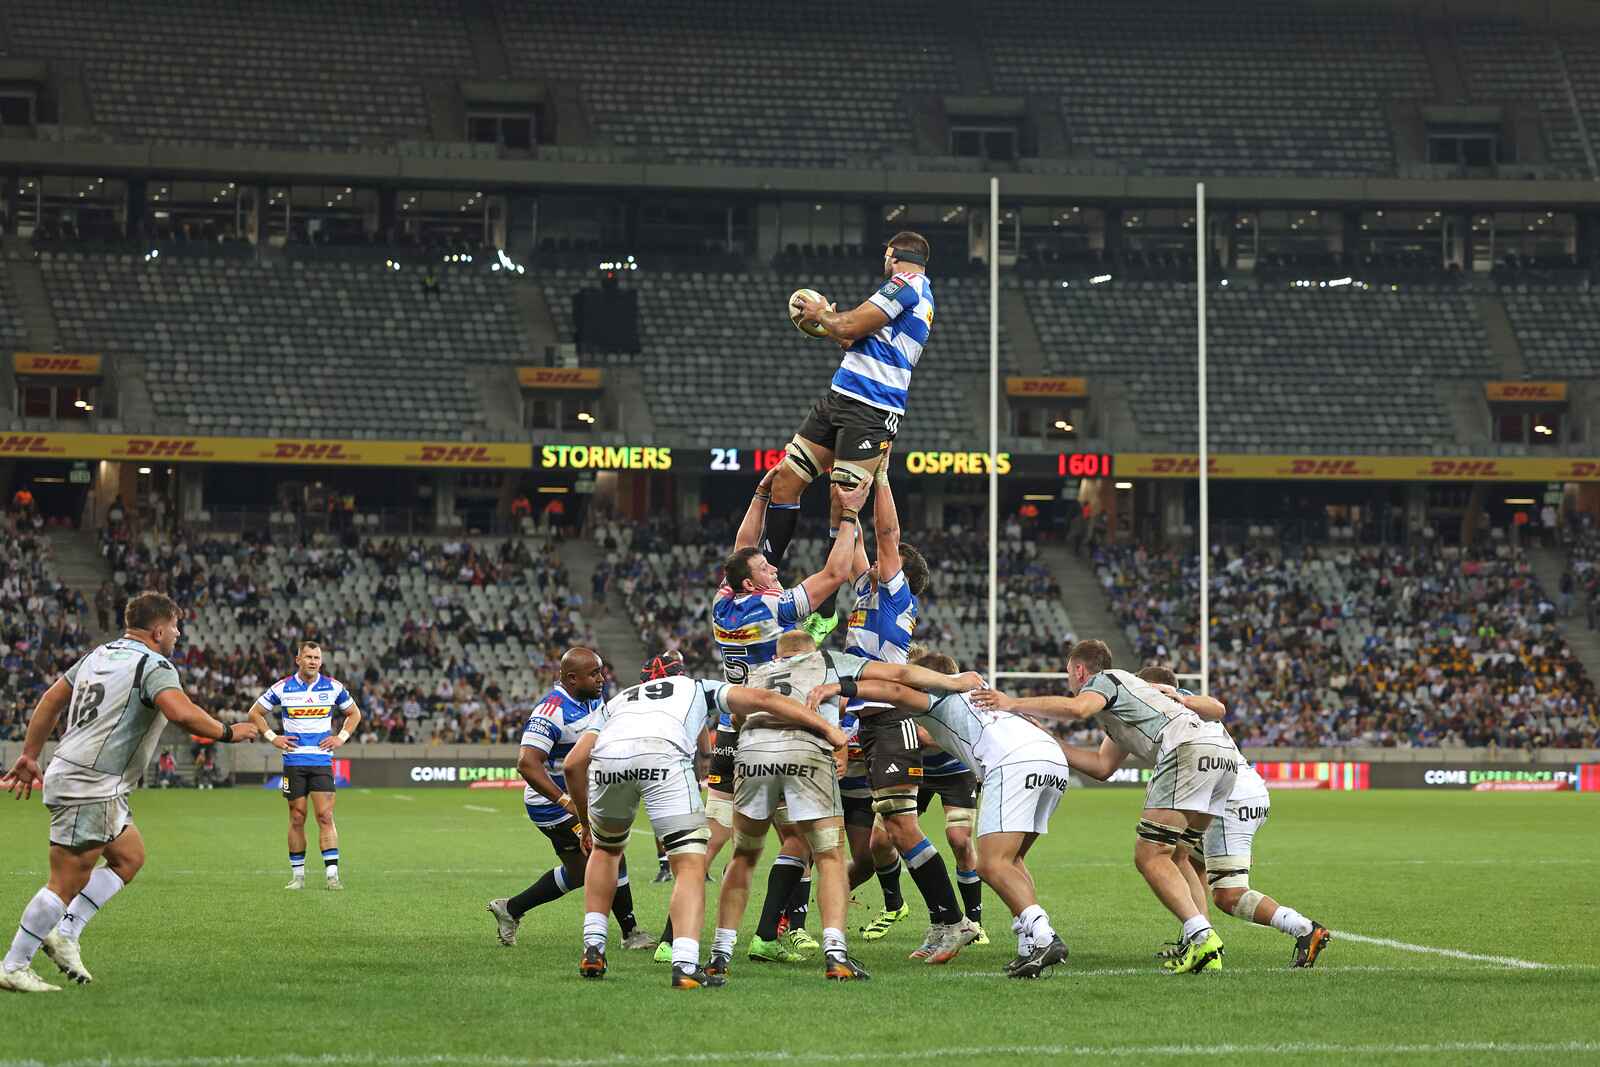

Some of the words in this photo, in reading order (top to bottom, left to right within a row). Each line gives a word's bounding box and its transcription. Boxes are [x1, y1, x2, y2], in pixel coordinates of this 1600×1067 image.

[536, 371, 584, 383] DHL
[1502, 386, 1550, 397] DHL
[0, 436, 50, 452] HL
[126, 440, 201, 456] DHL
[274, 443, 347, 460] DHL
[420, 446, 492, 462] DHL
[541, 445, 672, 469] STORMERS
[710, 448, 740, 471] 21
[906, 451, 1011, 475] OSPREYS
[1291, 460, 1360, 475] DHL
[1430, 461, 1499, 477] DHL
[722, 647, 749, 684] 5
[622, 681, 675, 702] 19
[767, 672, 792, 697] 5
[291, 708, 328, 716] DHL
[738, 763, 819, 779] QUINNBET
[1198, 756, 1238, 774] QUINN
[411, 767, 456, 781] COME
[459, 767, 521, 781] EXPERIE
[594, 768, 670, 786] QUINNBET
[1424, 770, 1467, 784] COME
[1469, 771, 1552, 784] EXPERIENCE
